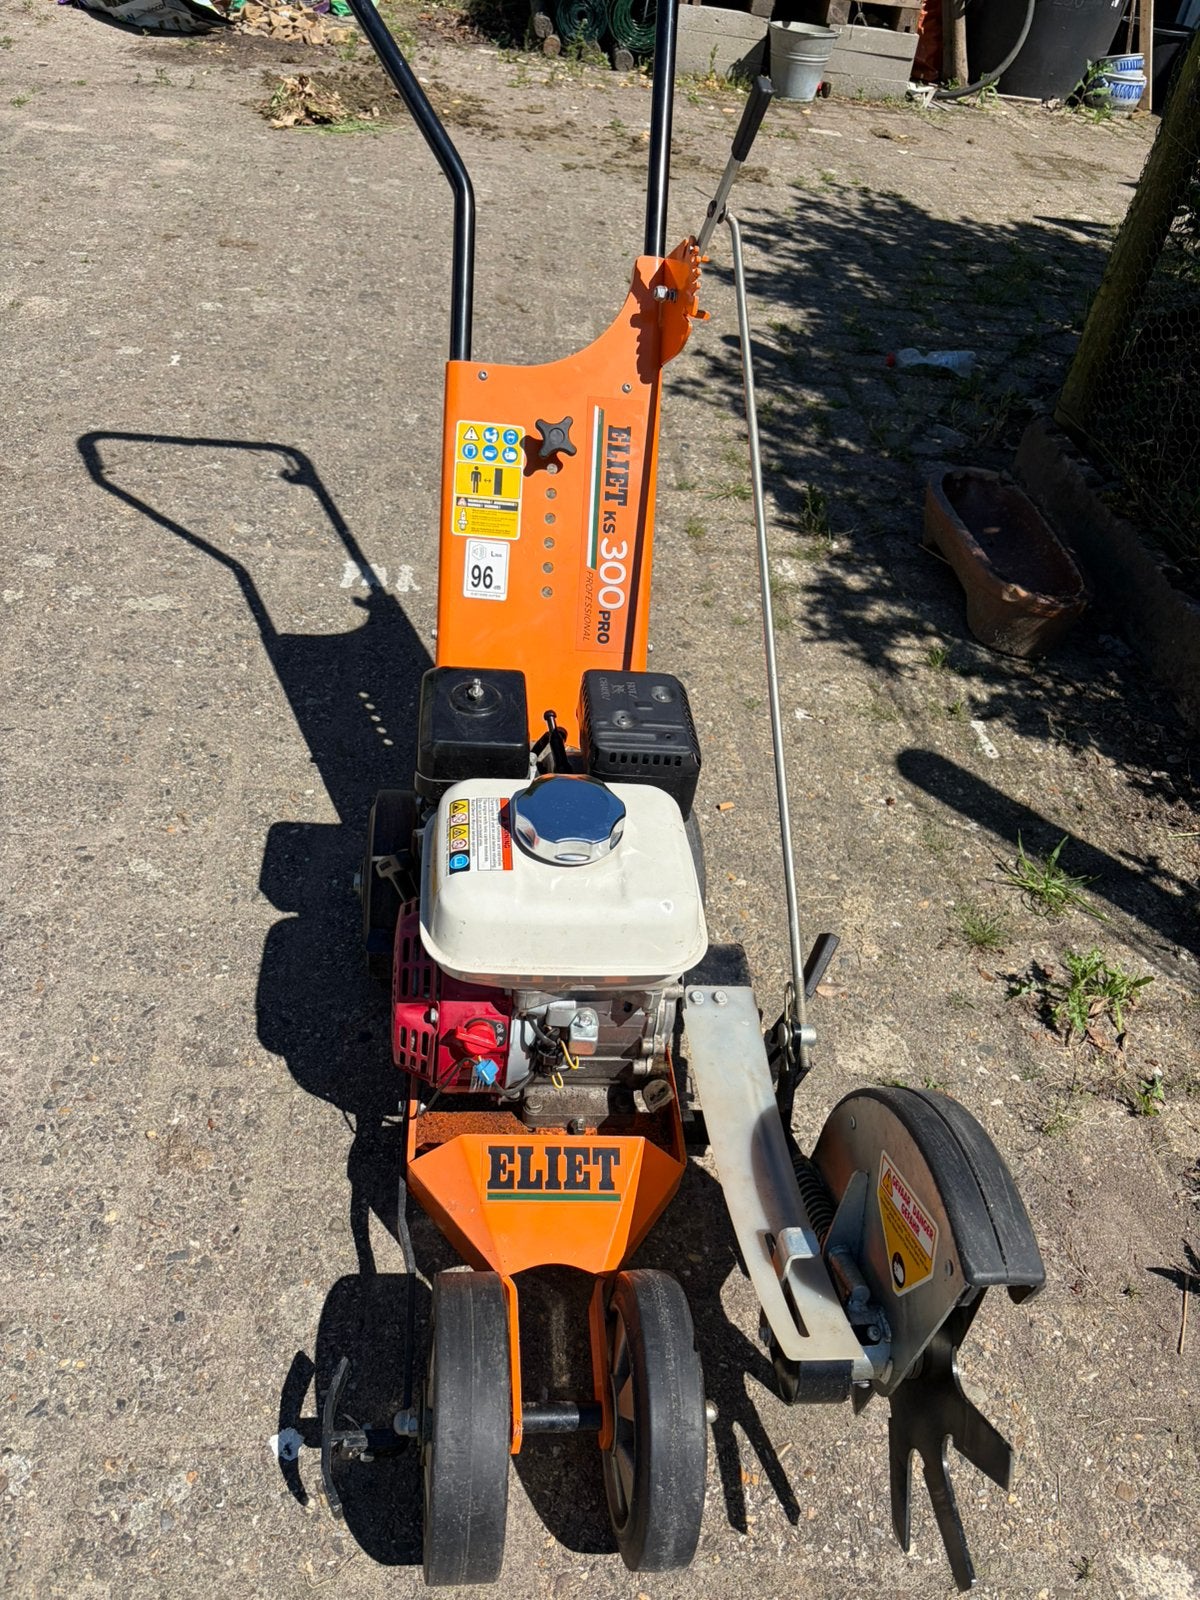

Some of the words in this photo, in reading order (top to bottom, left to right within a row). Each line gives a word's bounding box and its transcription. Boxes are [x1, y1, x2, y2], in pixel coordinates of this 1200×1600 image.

[604, 425, 632, 507] ELIET
[603, 511, 617, 535] KS
[471, 564, 493, 589] 96
[598, 537, 629, 610] 300
[583, 571, 594, 641] PROFESSIONAL
[597, 611, 611, 645] PRO
[487, 1146, 621, 1191] ELIET
[912, 1204, 934, 1241] DANGER
